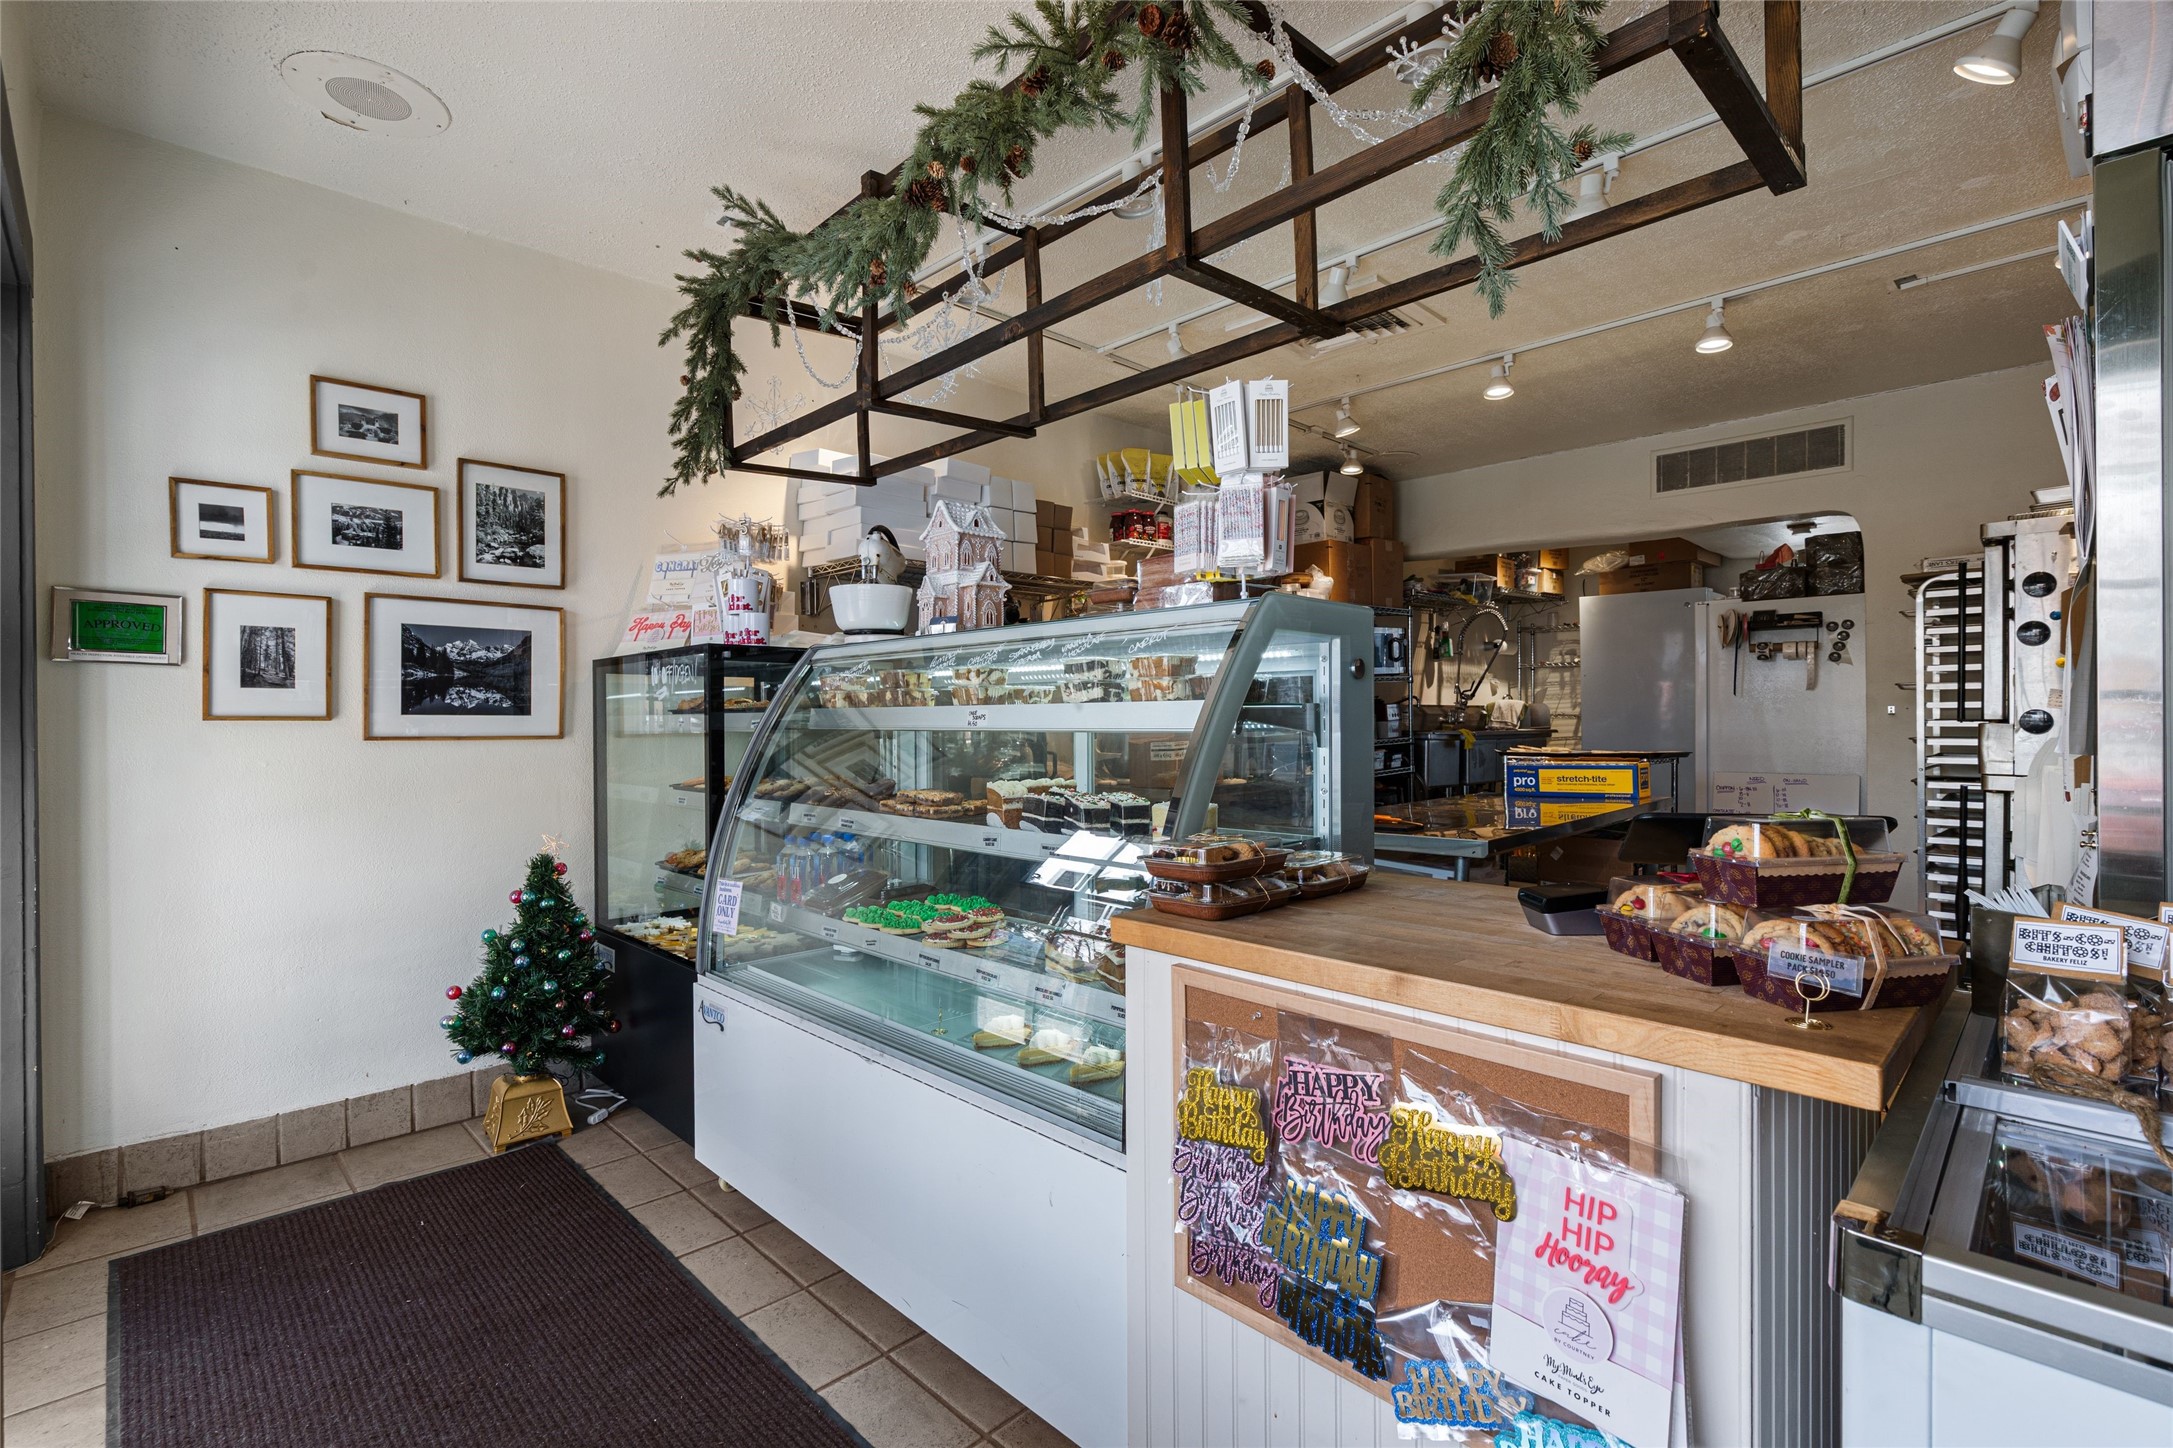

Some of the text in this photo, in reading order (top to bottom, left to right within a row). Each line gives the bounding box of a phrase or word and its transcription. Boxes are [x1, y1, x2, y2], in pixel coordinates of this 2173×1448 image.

[84, 619, 162, 632] APPROVED
[1128, 625, 1178, 653] CARROT
[1513, 777, 1536, 787] pro
[1556, 775, 1607, 783] stretch-tite
[717, 905, 736, 918] ONLY
[718, 894, 737, 907] CARD
[1780, 950, 1845, 970] COOKIE SAMPLER
[2024, 941, 2109, 961] CHITOS!
[2042, 955, 2088, 966] BAKERY FELIZ
[1787, 962, 1808, 974] PACK
[1184, 1070, 1258, 1128] Happy
[1290, 1070, 1380, 1102] HAPPY
[1177, 1102, 1268, 1163] Birthday
[1282, 1088, 1392, 1164] Birthday
[1391, 1107, 1500, 1178] Happy
[1379, 1142, 1517, 1221] Birthday
[1282, 1178, 1364, 1250] HAPPY
[1563, 1186, 1617, 1226] HIP
[1263, 1203, 1378, 1300] BIRTHDAY
[1561, 1216, 1615, 1256] HIP
[1535, 1231, 1635, 1305] Hooray
[1554, 1328, 1597, 1350] cake
[1563, 1342, 1595, 1360] COURTNEY
[1543, 1354, 1605, 1395] My Mind's Eye
[1395, 1390, 1529, 1423] BIRTHDY
[1534, 1371, 1611, 1417] CAKE TOPPER
